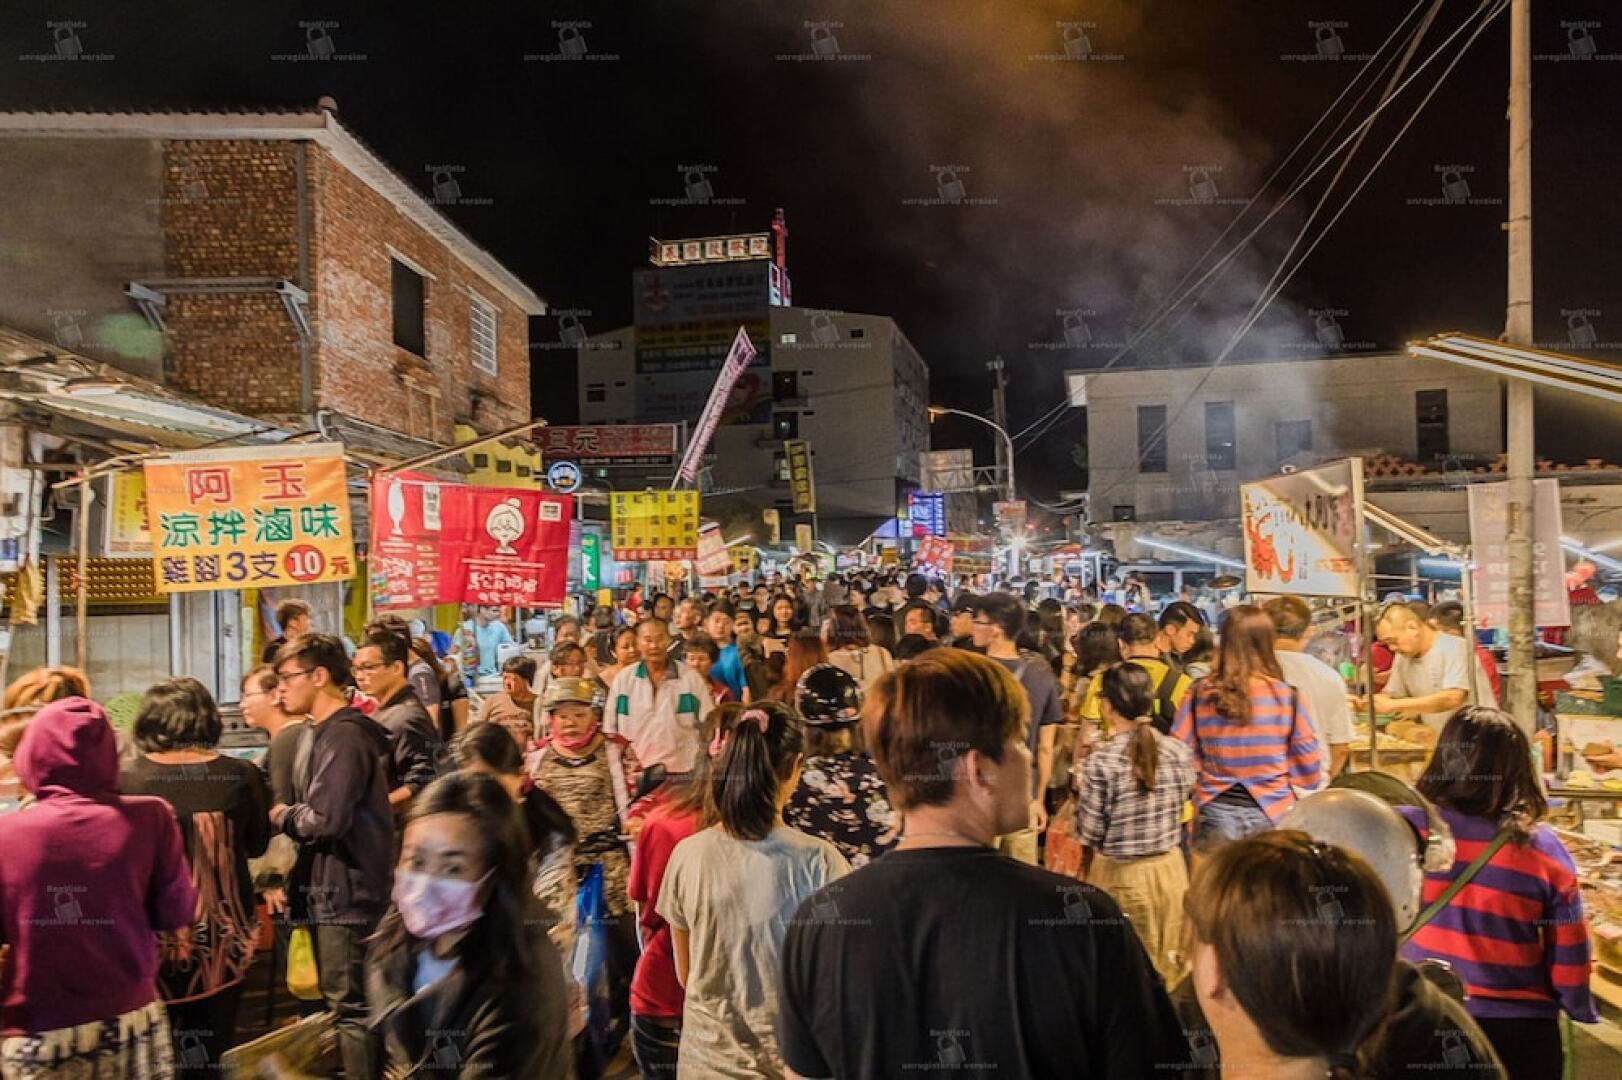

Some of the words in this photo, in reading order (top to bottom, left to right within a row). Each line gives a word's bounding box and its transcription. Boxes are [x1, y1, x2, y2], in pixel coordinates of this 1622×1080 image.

[187, 463, 308, 505] 阿玉
[160, 503, 341, 548] 涼拌滷味
